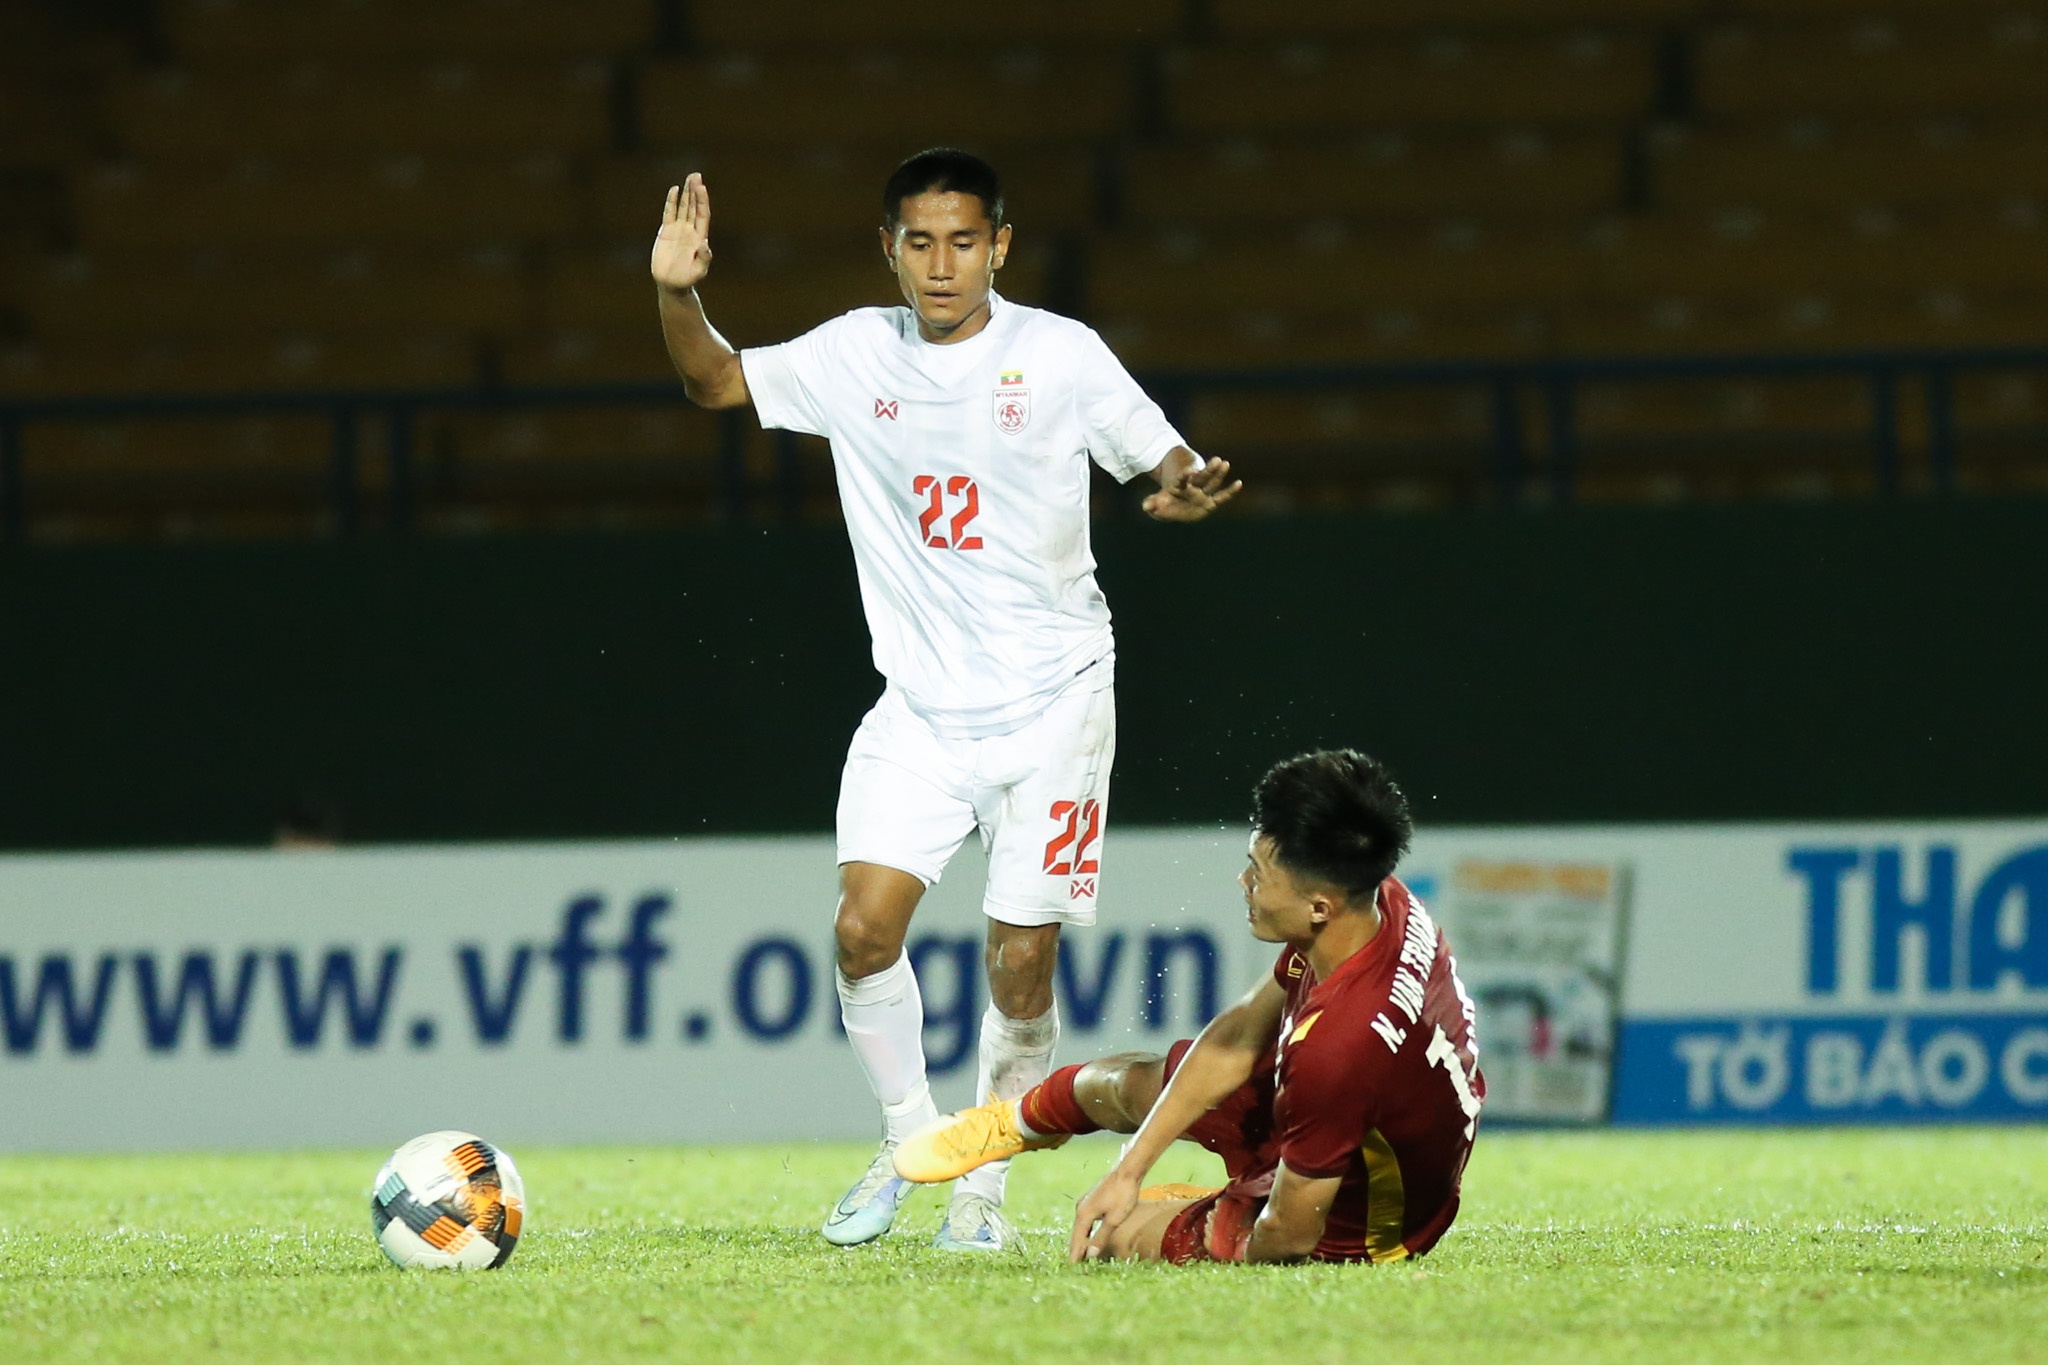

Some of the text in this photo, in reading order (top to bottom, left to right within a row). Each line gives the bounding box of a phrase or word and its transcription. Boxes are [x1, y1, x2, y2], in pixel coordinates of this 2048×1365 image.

[913, 475, 984, 551] 22
[1043, 798, 1099, 876] 22
[0, 889, 1221, 1074] www.vff.ogvn
[1370, 1011, 1407, 1054] N.
